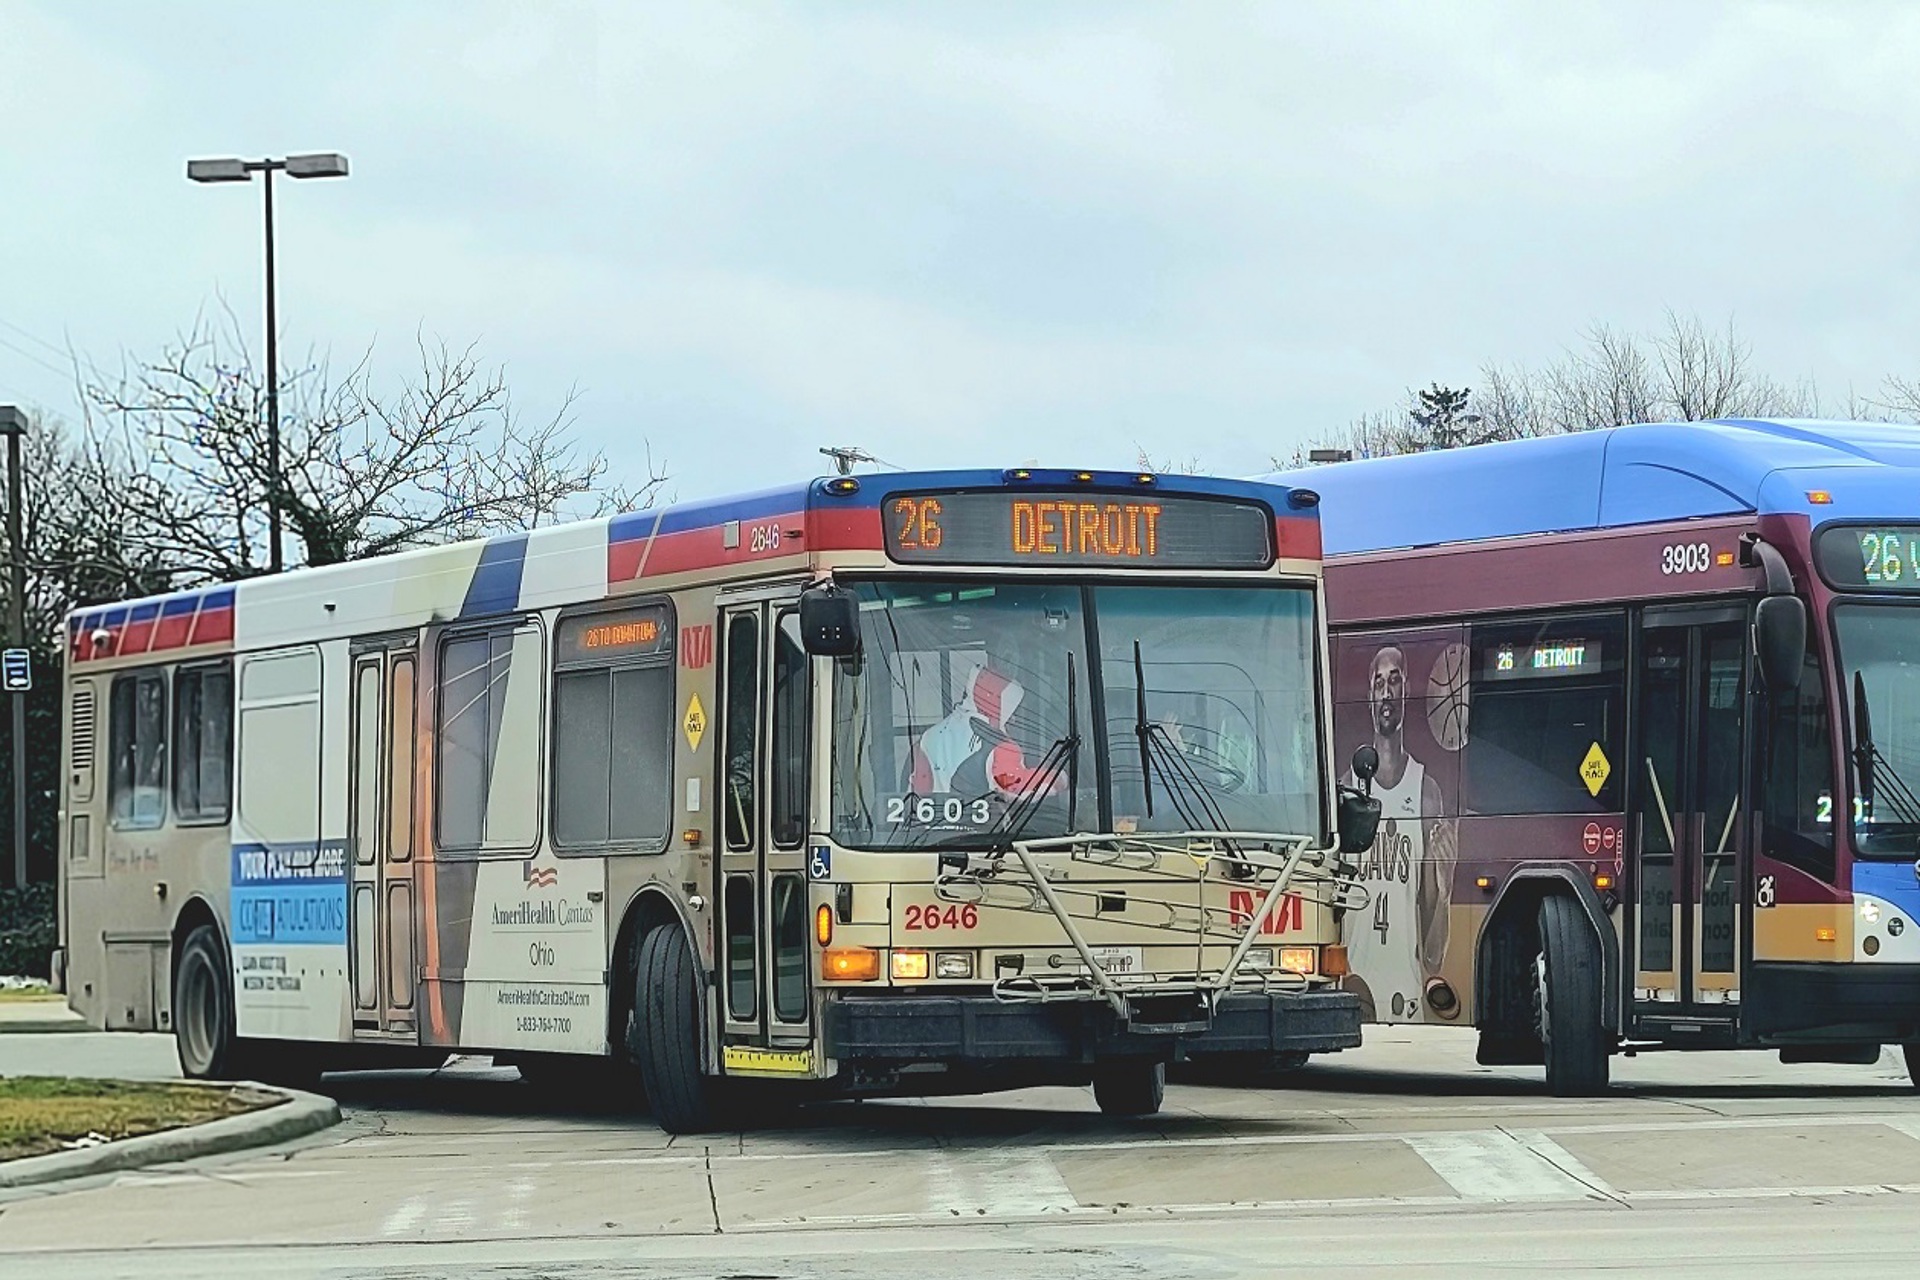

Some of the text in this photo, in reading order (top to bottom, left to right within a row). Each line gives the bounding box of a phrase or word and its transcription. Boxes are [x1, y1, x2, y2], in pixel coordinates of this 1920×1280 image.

[750, 523, 780, 552] 2646
[895, 499, 1161, 556] 26 DETROIT
[1661, 542, 1710, 575] 3903
[1862, 533, 1901, 581] 26
[587, 630, 599, 646] 26
[600, 627, 610, 645] TO
[1497, 647, 1585, 671] 26 DETROIT
[1588, 760, 1601, 769] SAFE
[886, 797, 990, 824] 2603
[492, 899, 593, 926] AmeriHealth Caritas
[904, 904, 978, 930] 2646
[1373, 891, 1390, 945] 4
[529, 941, 555, 966] Ohio
